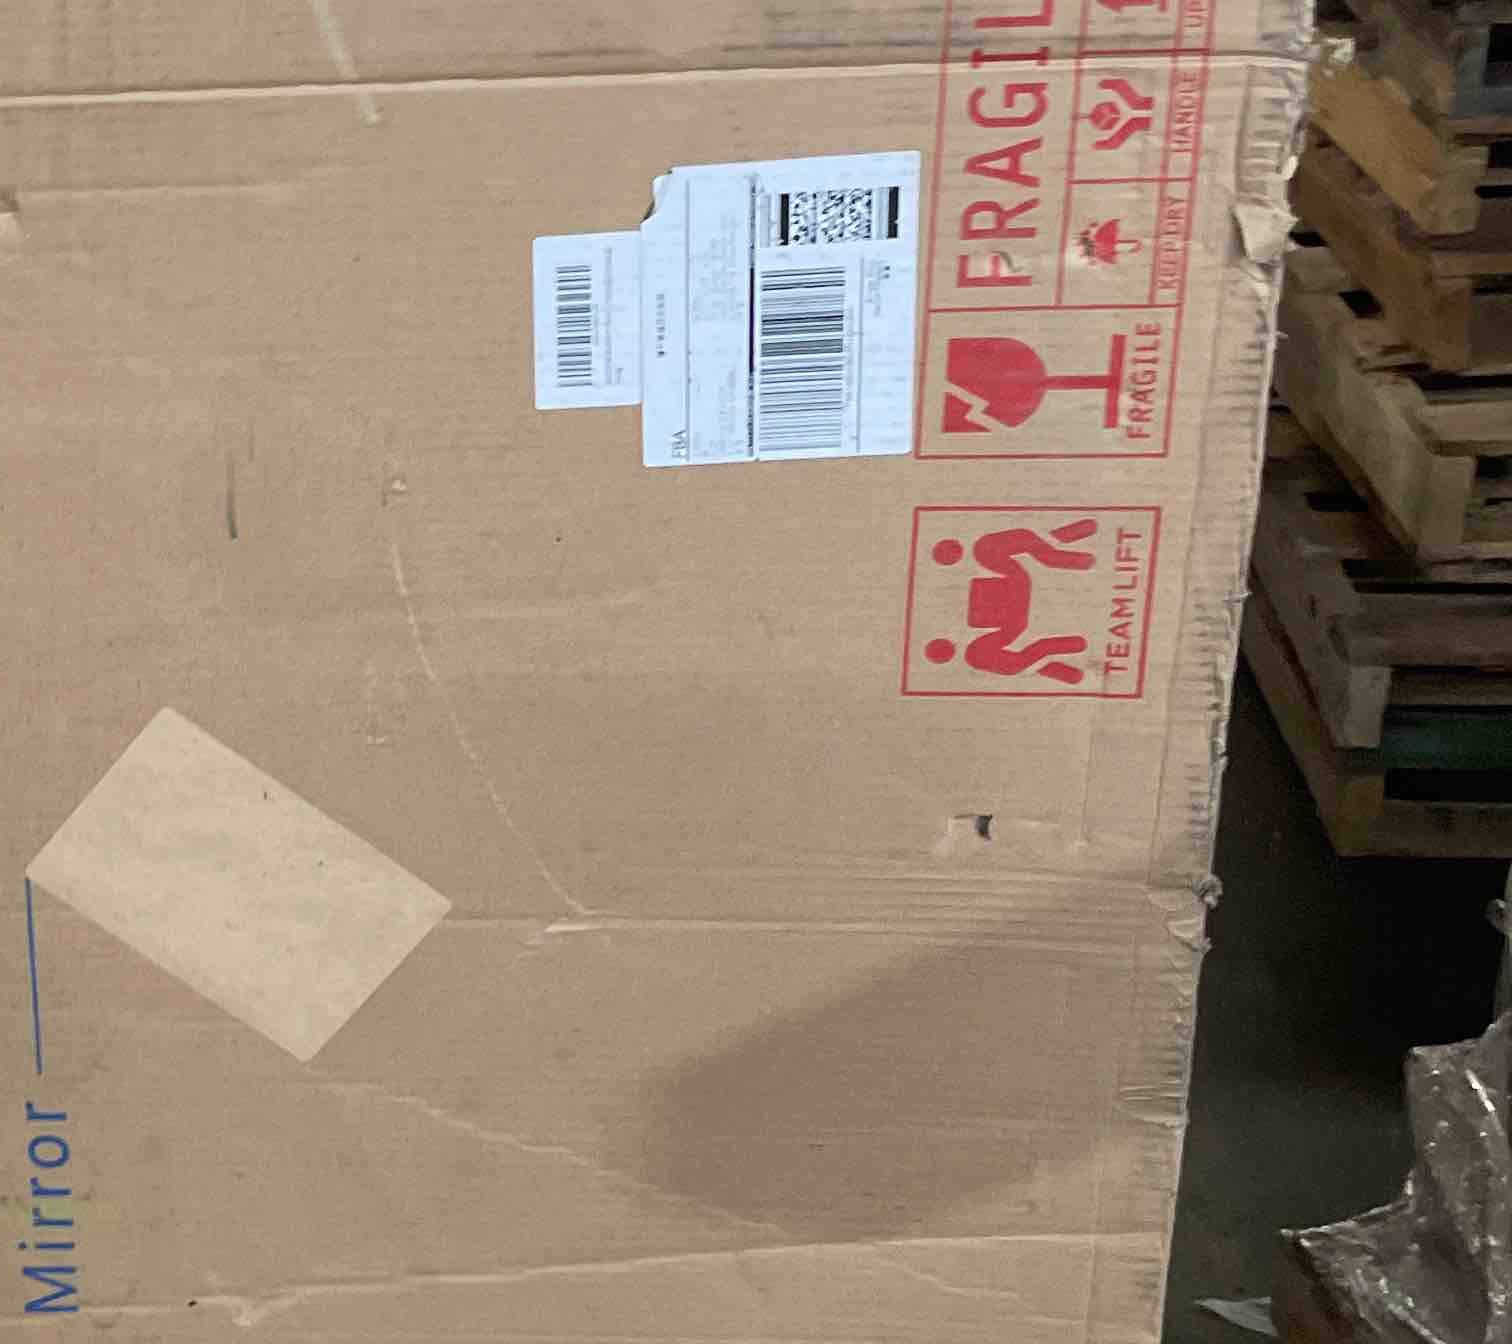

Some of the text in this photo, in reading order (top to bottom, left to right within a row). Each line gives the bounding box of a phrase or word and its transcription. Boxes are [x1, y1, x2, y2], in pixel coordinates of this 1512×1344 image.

[1125, 321, 1162, 439] FRAGILE
[1103, 527, 1143, 674] TEAM LIFT
[18, 1100, 80, 1314] Mirror
